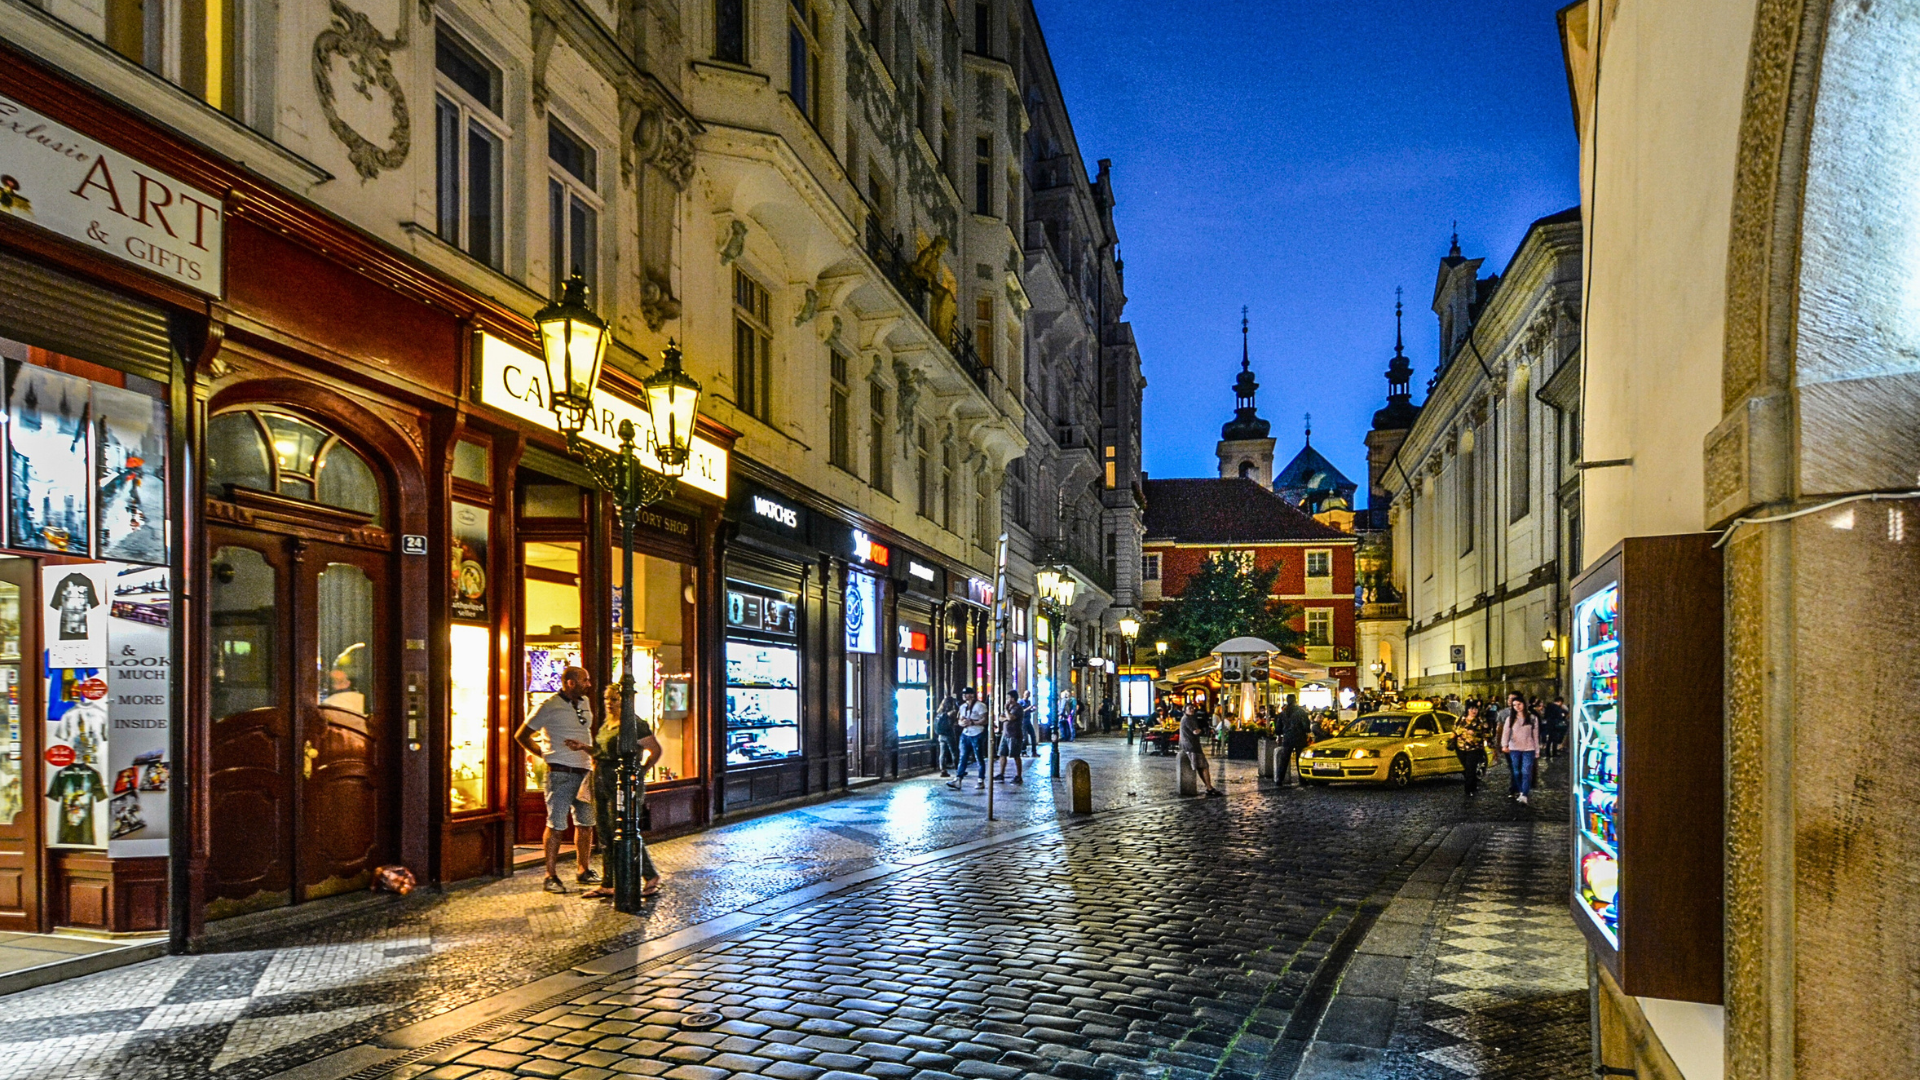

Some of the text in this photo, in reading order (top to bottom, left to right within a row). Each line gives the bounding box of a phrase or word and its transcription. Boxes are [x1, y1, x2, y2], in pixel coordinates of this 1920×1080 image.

[69, 154, 219, 252] ART
[87, 220, 202, 281] & GIFTS
[753, 495, 797, 528] WATCHES
[664, 517, 689, 535] SHOP
[407, 537, 422, 548] 24
[121, 645, 136, 656] &
[118, 670, 165, 680] MUCH
[118, 695, 164, 705] MORE
[114, 719, 167, 729] INSIDE
